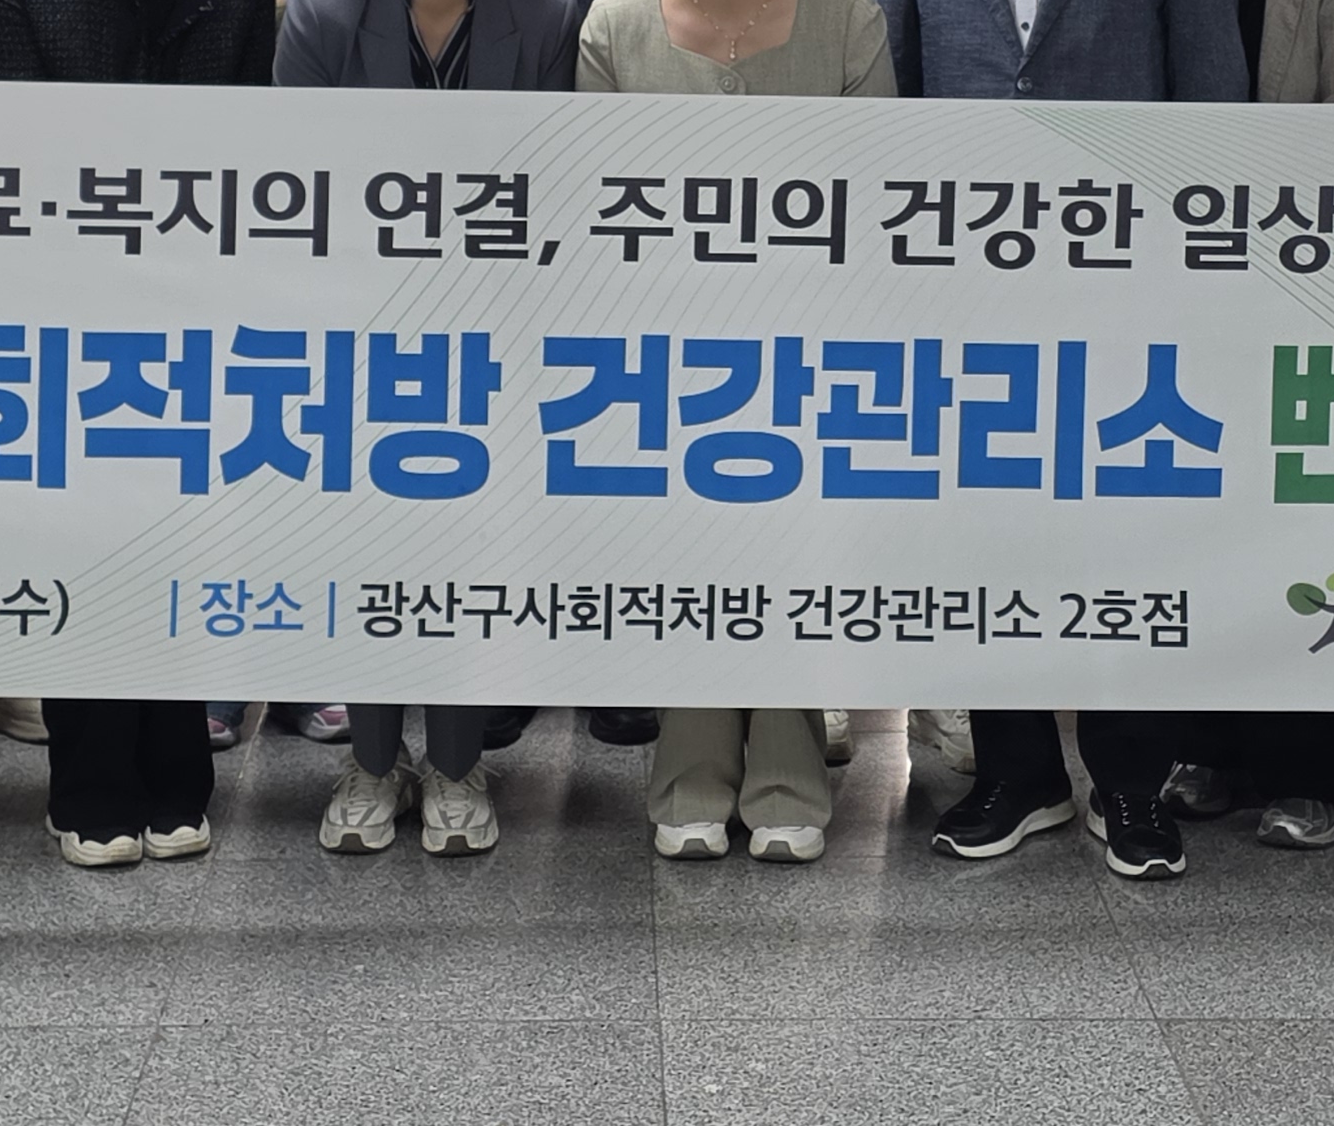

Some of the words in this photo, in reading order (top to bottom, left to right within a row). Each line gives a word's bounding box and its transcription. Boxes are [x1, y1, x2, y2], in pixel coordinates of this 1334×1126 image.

[363, 168, 561, 267] 연결,
[589, 176, 849, 265] 주민의
[878, 178, 1145, 271] 건강한
[537, 332, 1225, 504] 건강관리소
[199, 578, 306, 639] 장소
[357, 580, 772, 642] 광산구사회적처방
[787, 585, 1043, 645] 건강관리소
[1058, 589, 1192, 650] 2호점
